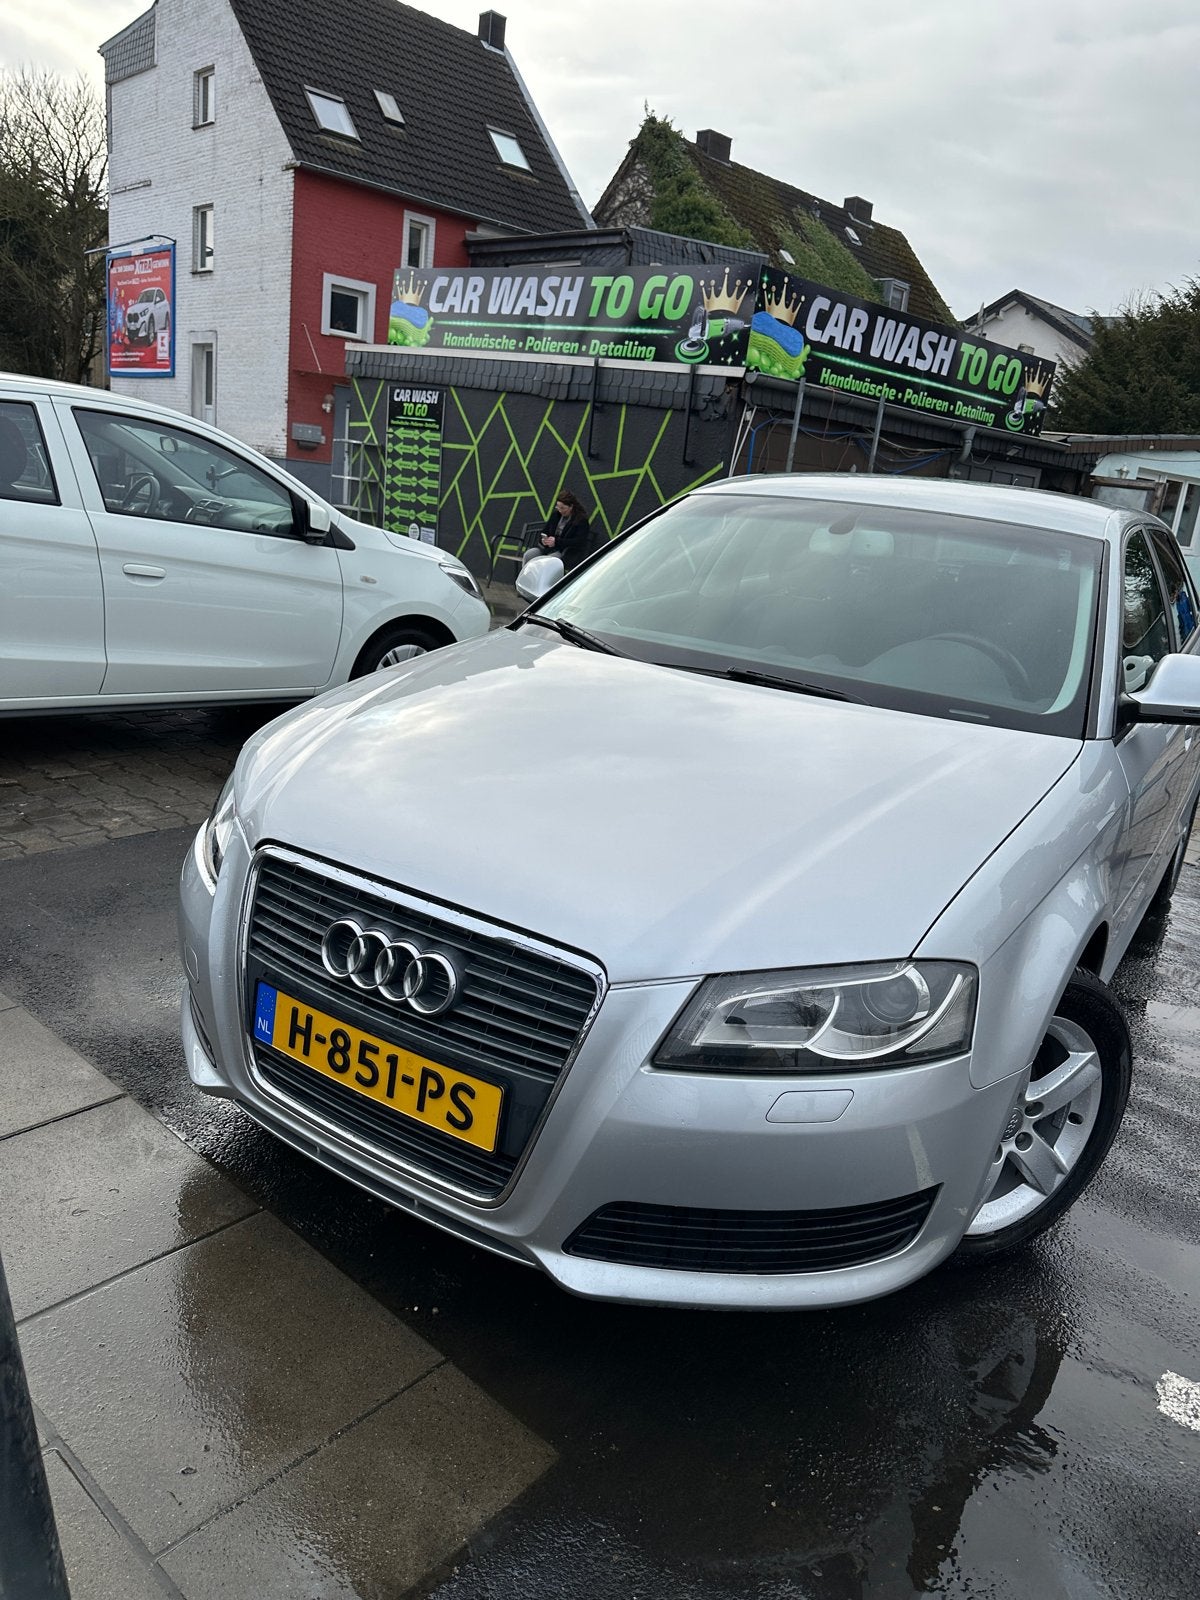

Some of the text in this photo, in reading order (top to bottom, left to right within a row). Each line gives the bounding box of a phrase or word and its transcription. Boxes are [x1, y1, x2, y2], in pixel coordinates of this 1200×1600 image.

[429, 275, 694, 320] CAR WASH TO GO
[443, 332, 656, 361] Handwäsche Polieren Detailing
[805, 296, 1022, 395] CAR WASH TO GO
[393, 388, 439, 404] CAR WASH
[403, 403, 428, 417] TO GO
[819, 367, 995, 424] Handwäsche Polieren Detailing
[257, 1016, 271, 1035] NL
[288, 1006, 476, 1131] H-851-PS
